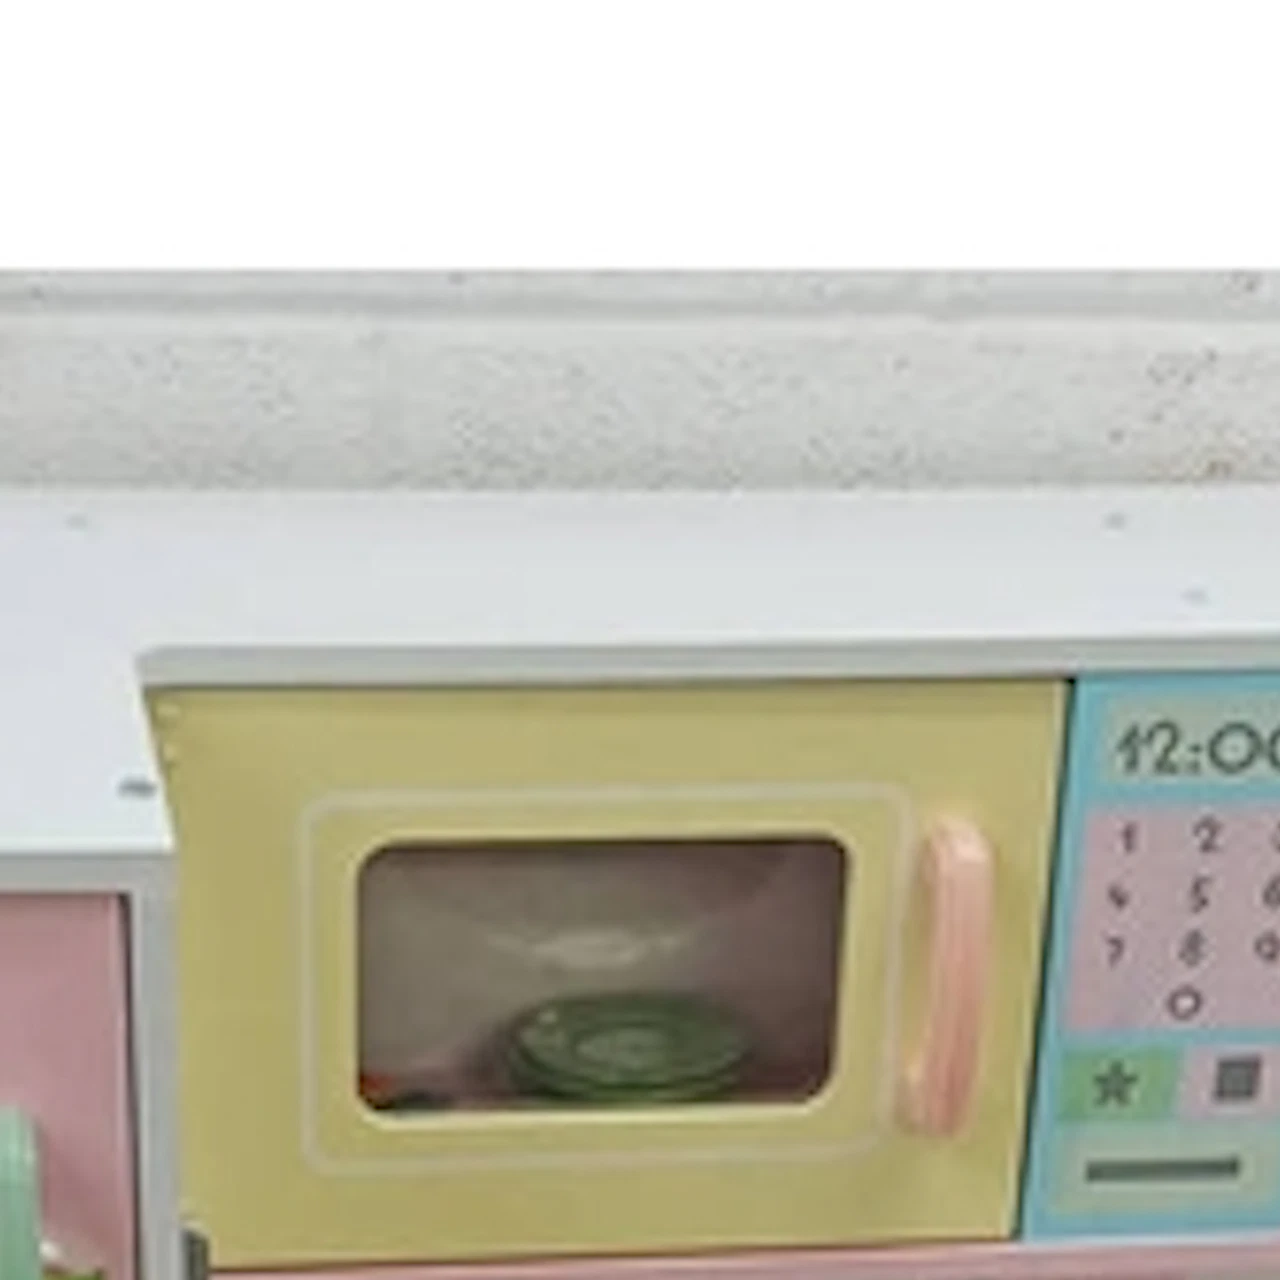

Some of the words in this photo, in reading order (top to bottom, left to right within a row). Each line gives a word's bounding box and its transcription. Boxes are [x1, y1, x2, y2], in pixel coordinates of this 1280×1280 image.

[1121, 821, 1139, 854] 1
[1192, 816, 1221, 853] 2
[1189, 875, 1213, 913] 5
[1104, 935, 1125, 968] 7
